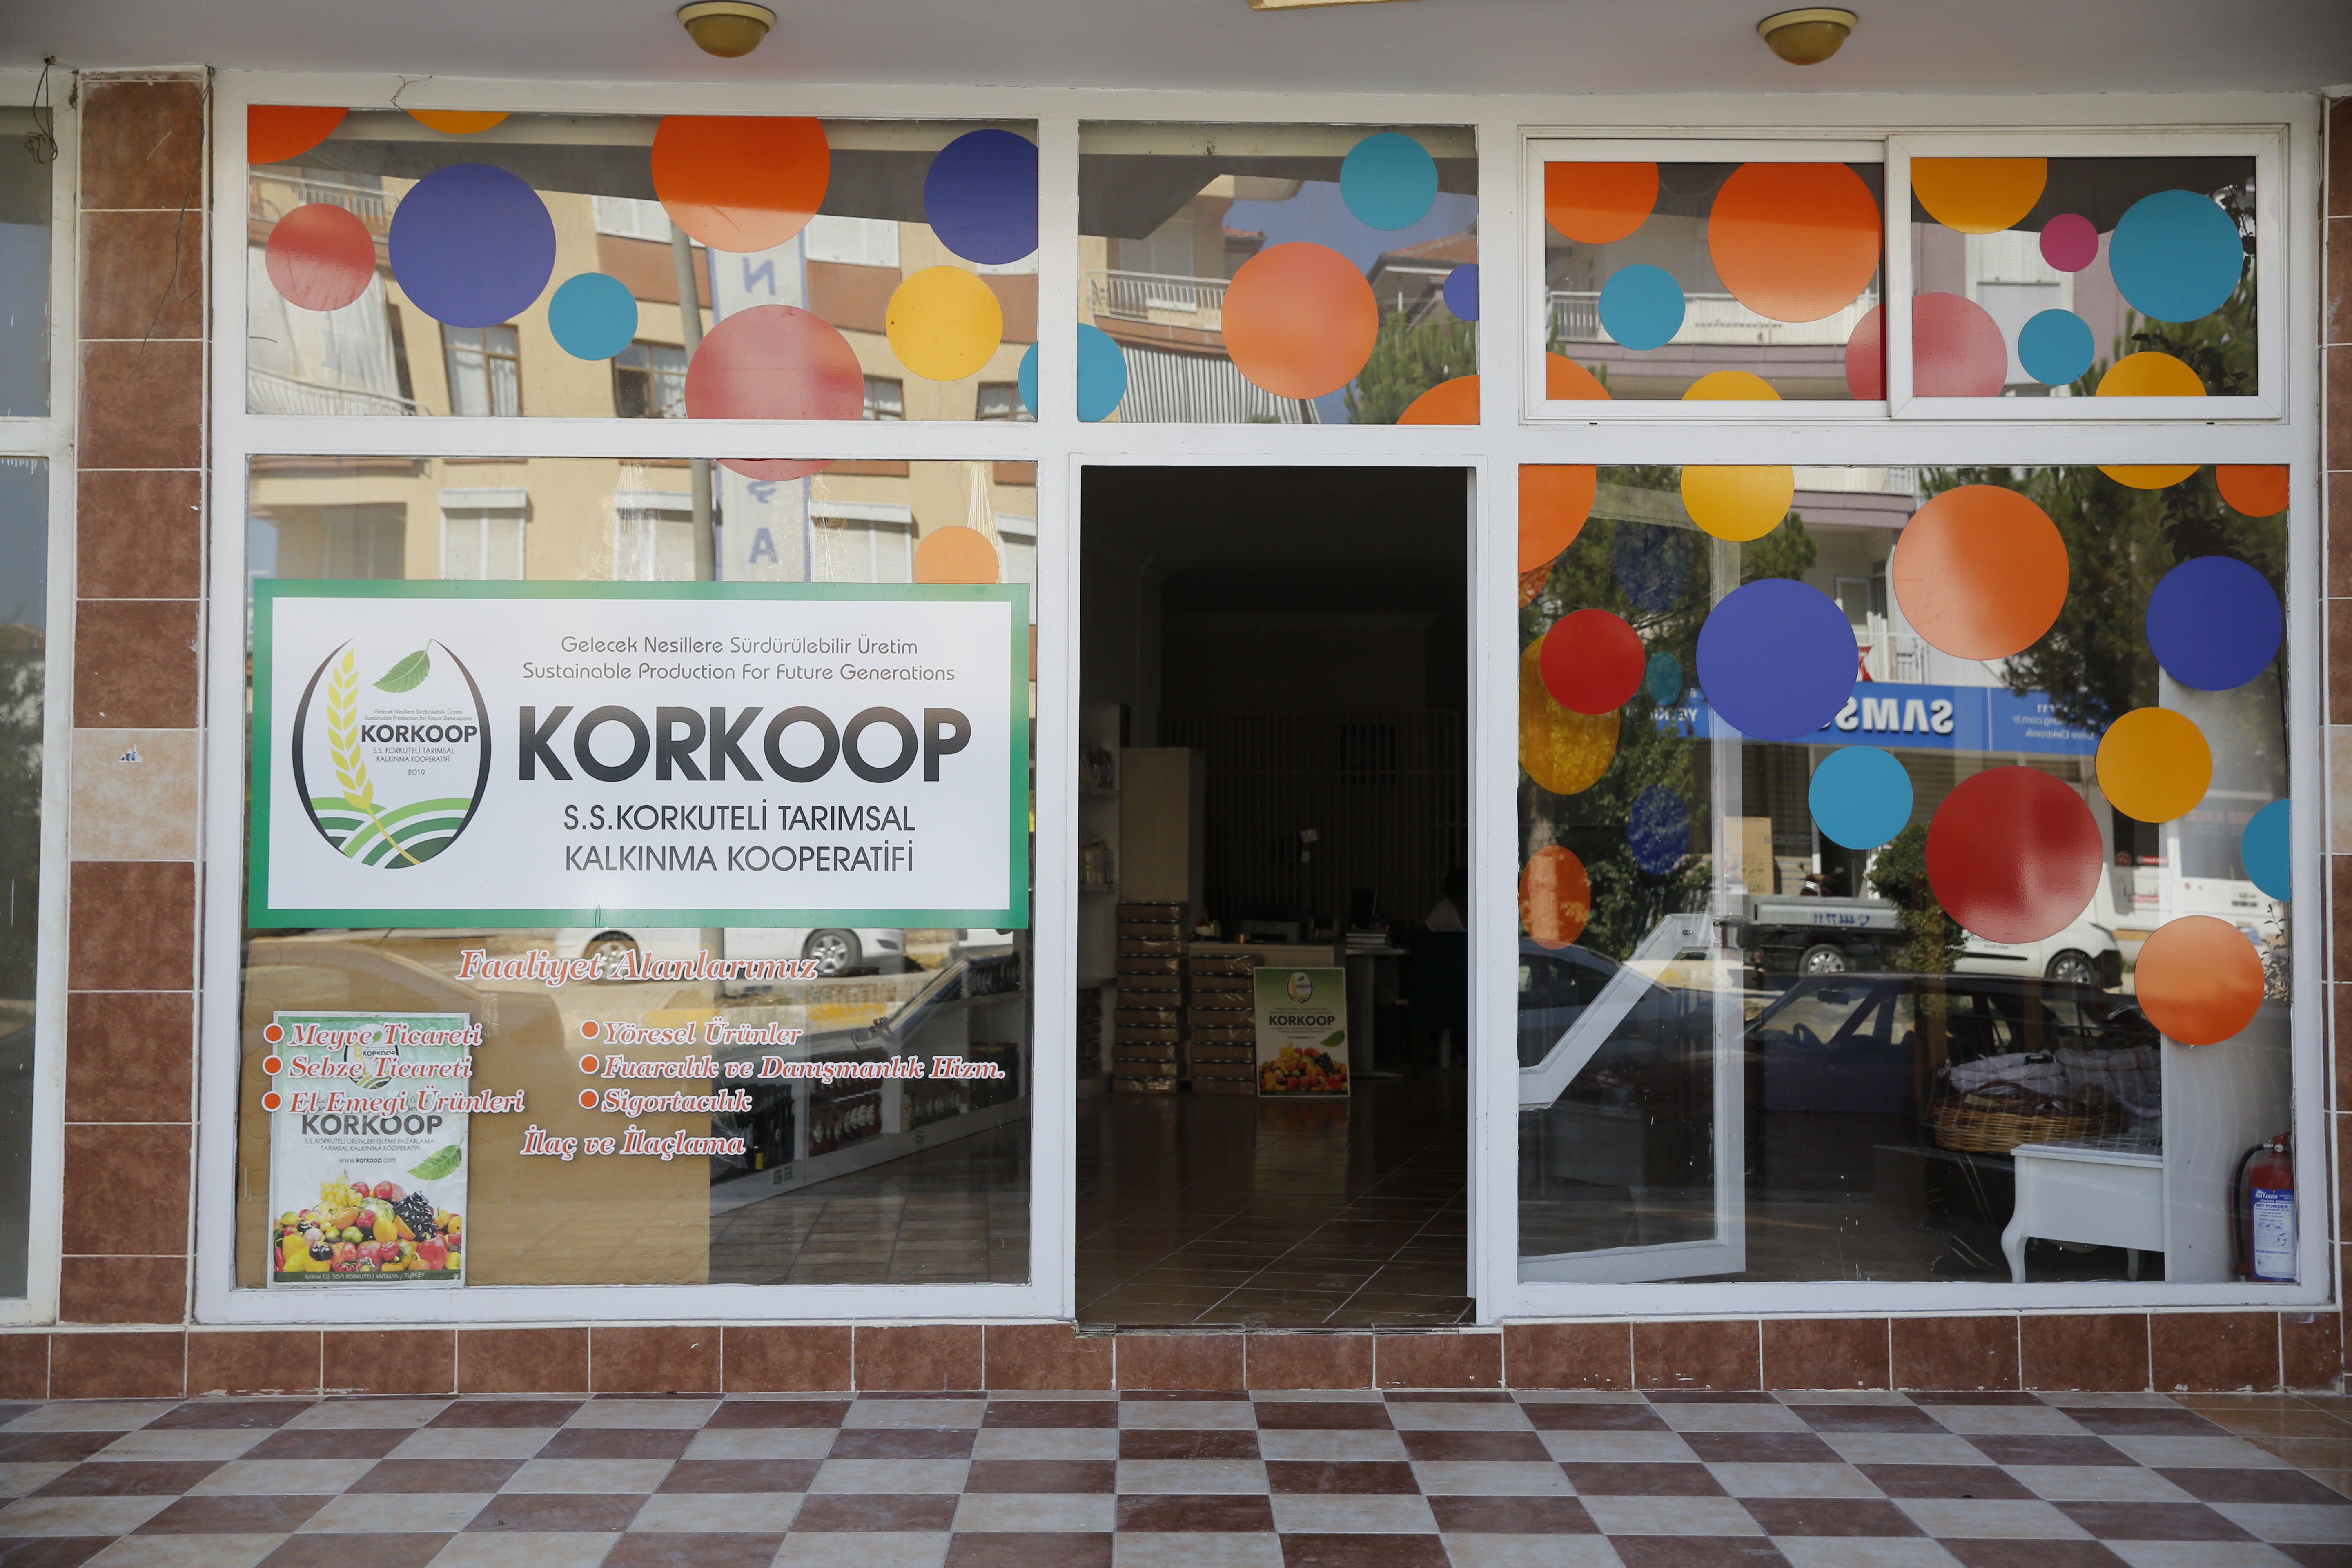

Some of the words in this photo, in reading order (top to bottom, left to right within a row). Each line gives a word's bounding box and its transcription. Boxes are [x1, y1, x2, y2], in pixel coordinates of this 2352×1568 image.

[561, 636, 637, 654] Gelecek
[644, 636, 724, 654] Nesillere
[730, 636, 851, 655] Sürdürülebilir
[858, 634, 918, 655] Üretim
[523, 662, 632, 680] Sustainable
[638, 662, 735, 680] Production
[742, 664, 770, 681] For
[776, 664, 834, 681] Future
[840, 663, 956, 682] Generations
[361, 725, 477, 743] KORKOOP
[518, 705, 971, 783] KORKOOP
[564, 798, 767, 831] S.S.KORKUTELİ
[778, 806, 915, 831] TARIMSAL
[566, 845, 717, 872] KALKINMA
[728, 840, 913, 872] KOOPERATİFİ
[457, 949, 602, 987] Faaliyet
[611, 950, 820, 980] Alanlarımız
[604, 1022, 695, 1044] Yöresel
[705, 1017, 802, 1044] Ürünler
[1269, 1016, 1335, 1026] KORKOOP
[288, 1024, 372, 1050] Meyve
[383, 1023, 482, 1046] Ticareti
[290, 1055, 362, 1078] Sebze
[373, 1056, 472, 1078] Ticareti
[602, 1055, 718, 1078] Fuarcılık
[726, 1062, 752, 1078] ve
[758, 1056, 924, 1083] Danışmanlık
[929, 1056, 1004, 1079] Hizm.
[288, 1090, 319, 1113] El
[417, 1085, 524, 1113] Ürünleri
[602, 1089, 751, 1118] Sigortacılık
[302, 1114, 442, 1136] KORKOOP
[521, 1125, 577, 1160] İlaç
[585, 1137, 614, 1154] ve
[620, 1125, 745, 1160] İlaçlama
